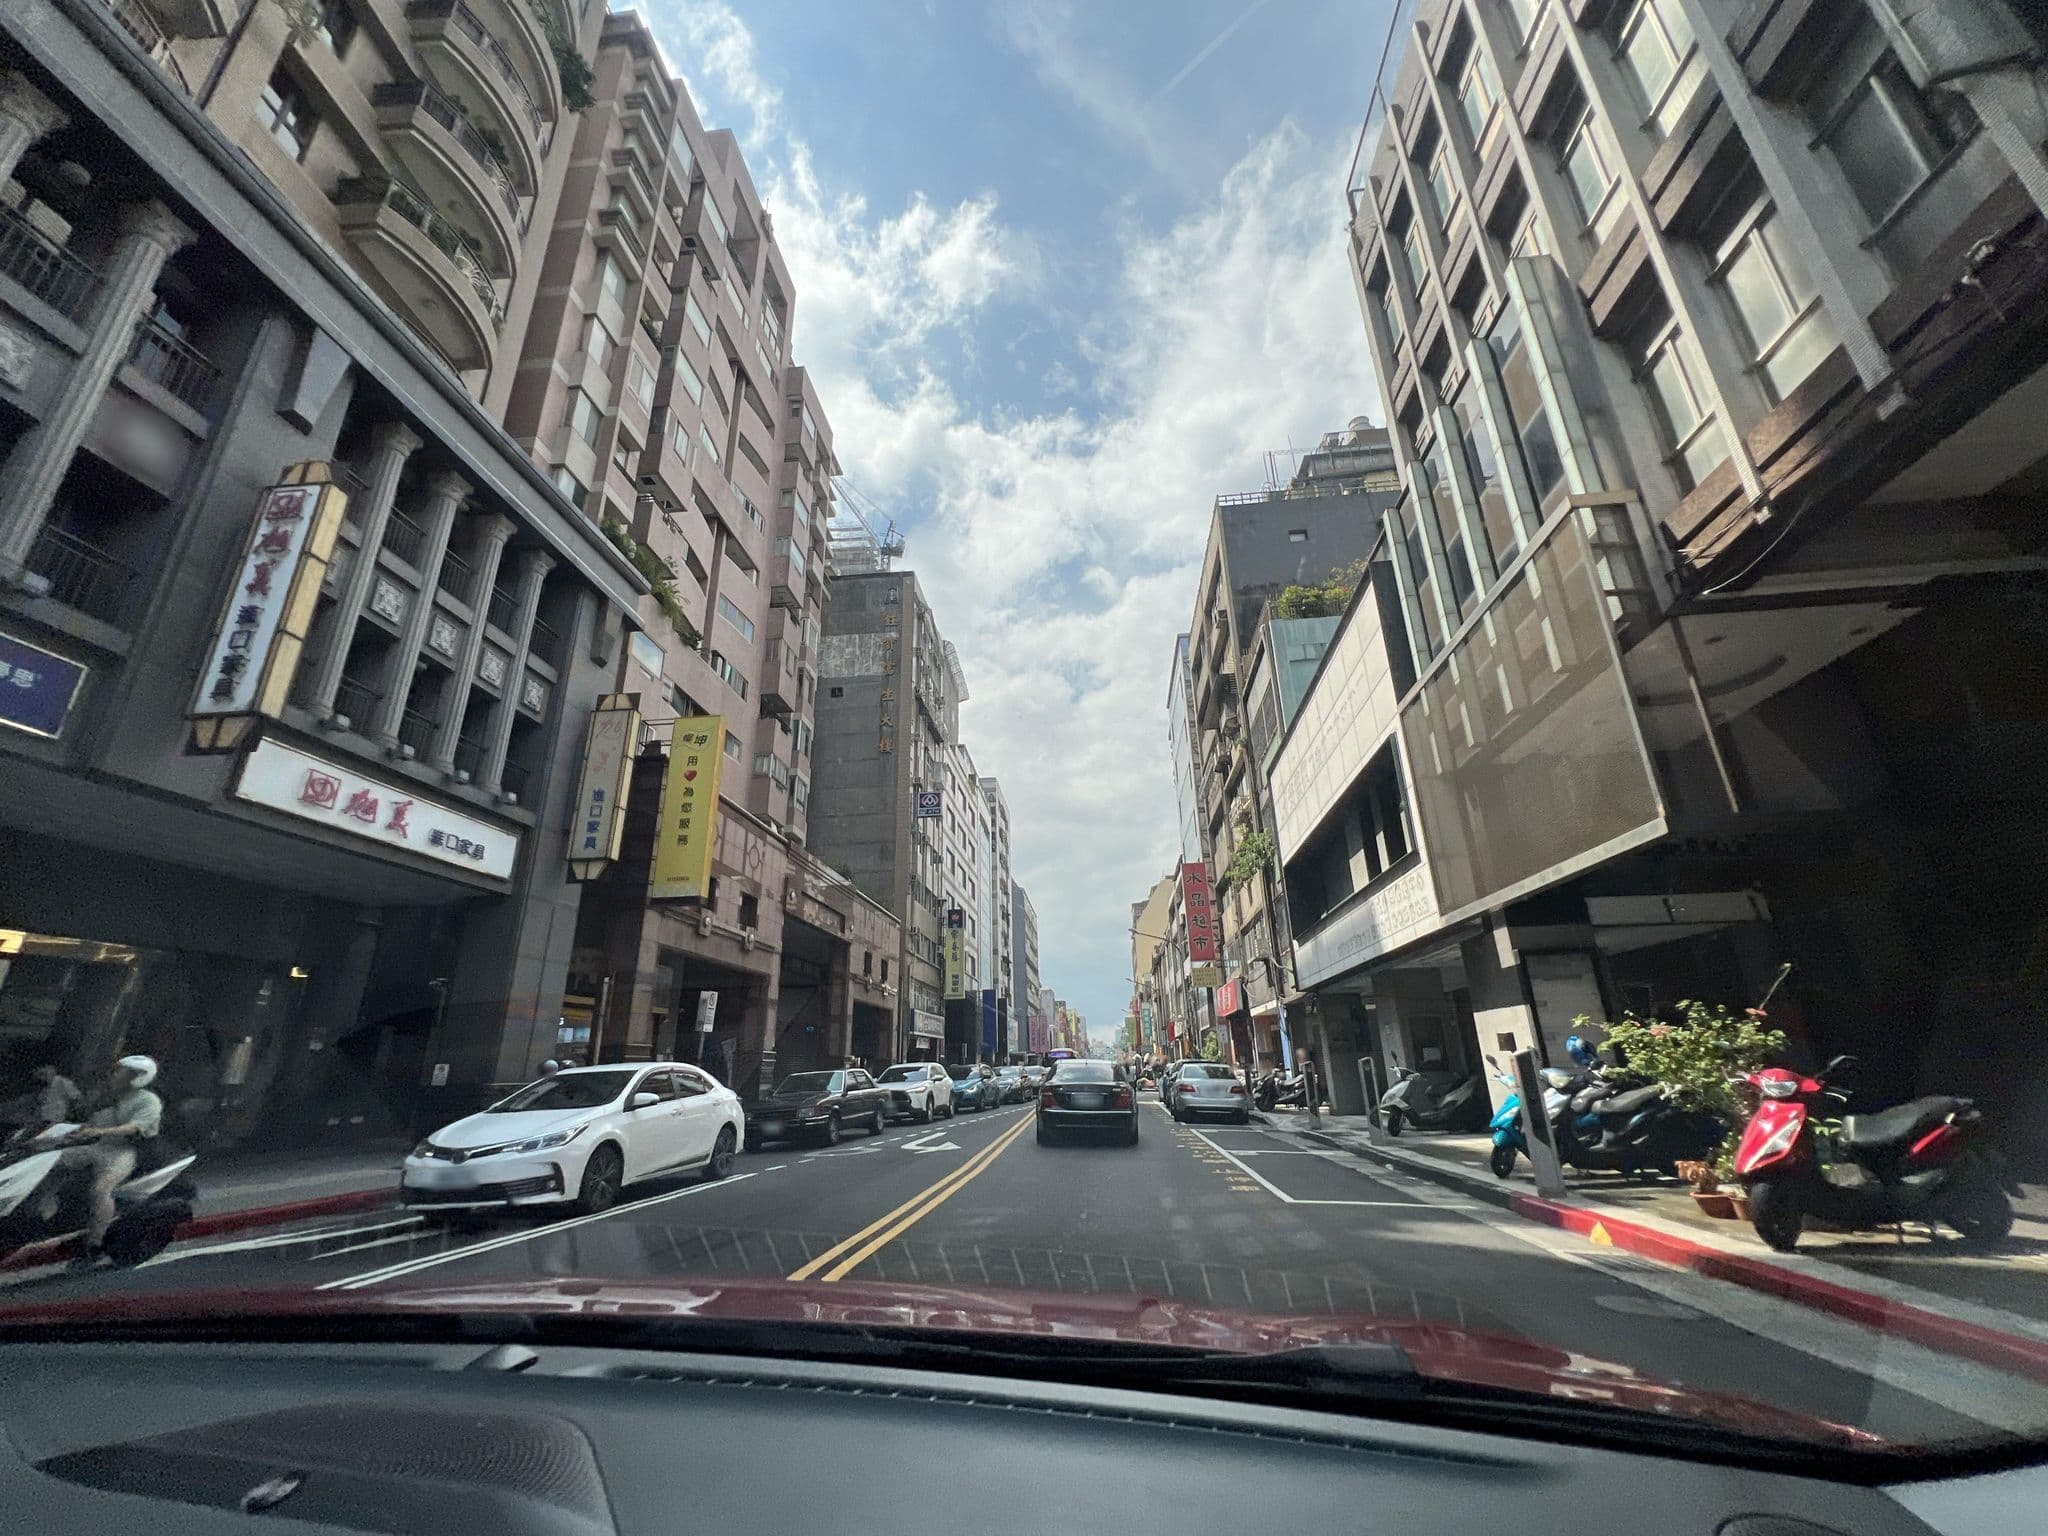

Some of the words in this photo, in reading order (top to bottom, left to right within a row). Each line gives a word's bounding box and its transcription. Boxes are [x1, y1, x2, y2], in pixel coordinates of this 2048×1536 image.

[583, 787, 605, 850] 進口家具
[1186, 871, 1209, 952] 水晶超市
